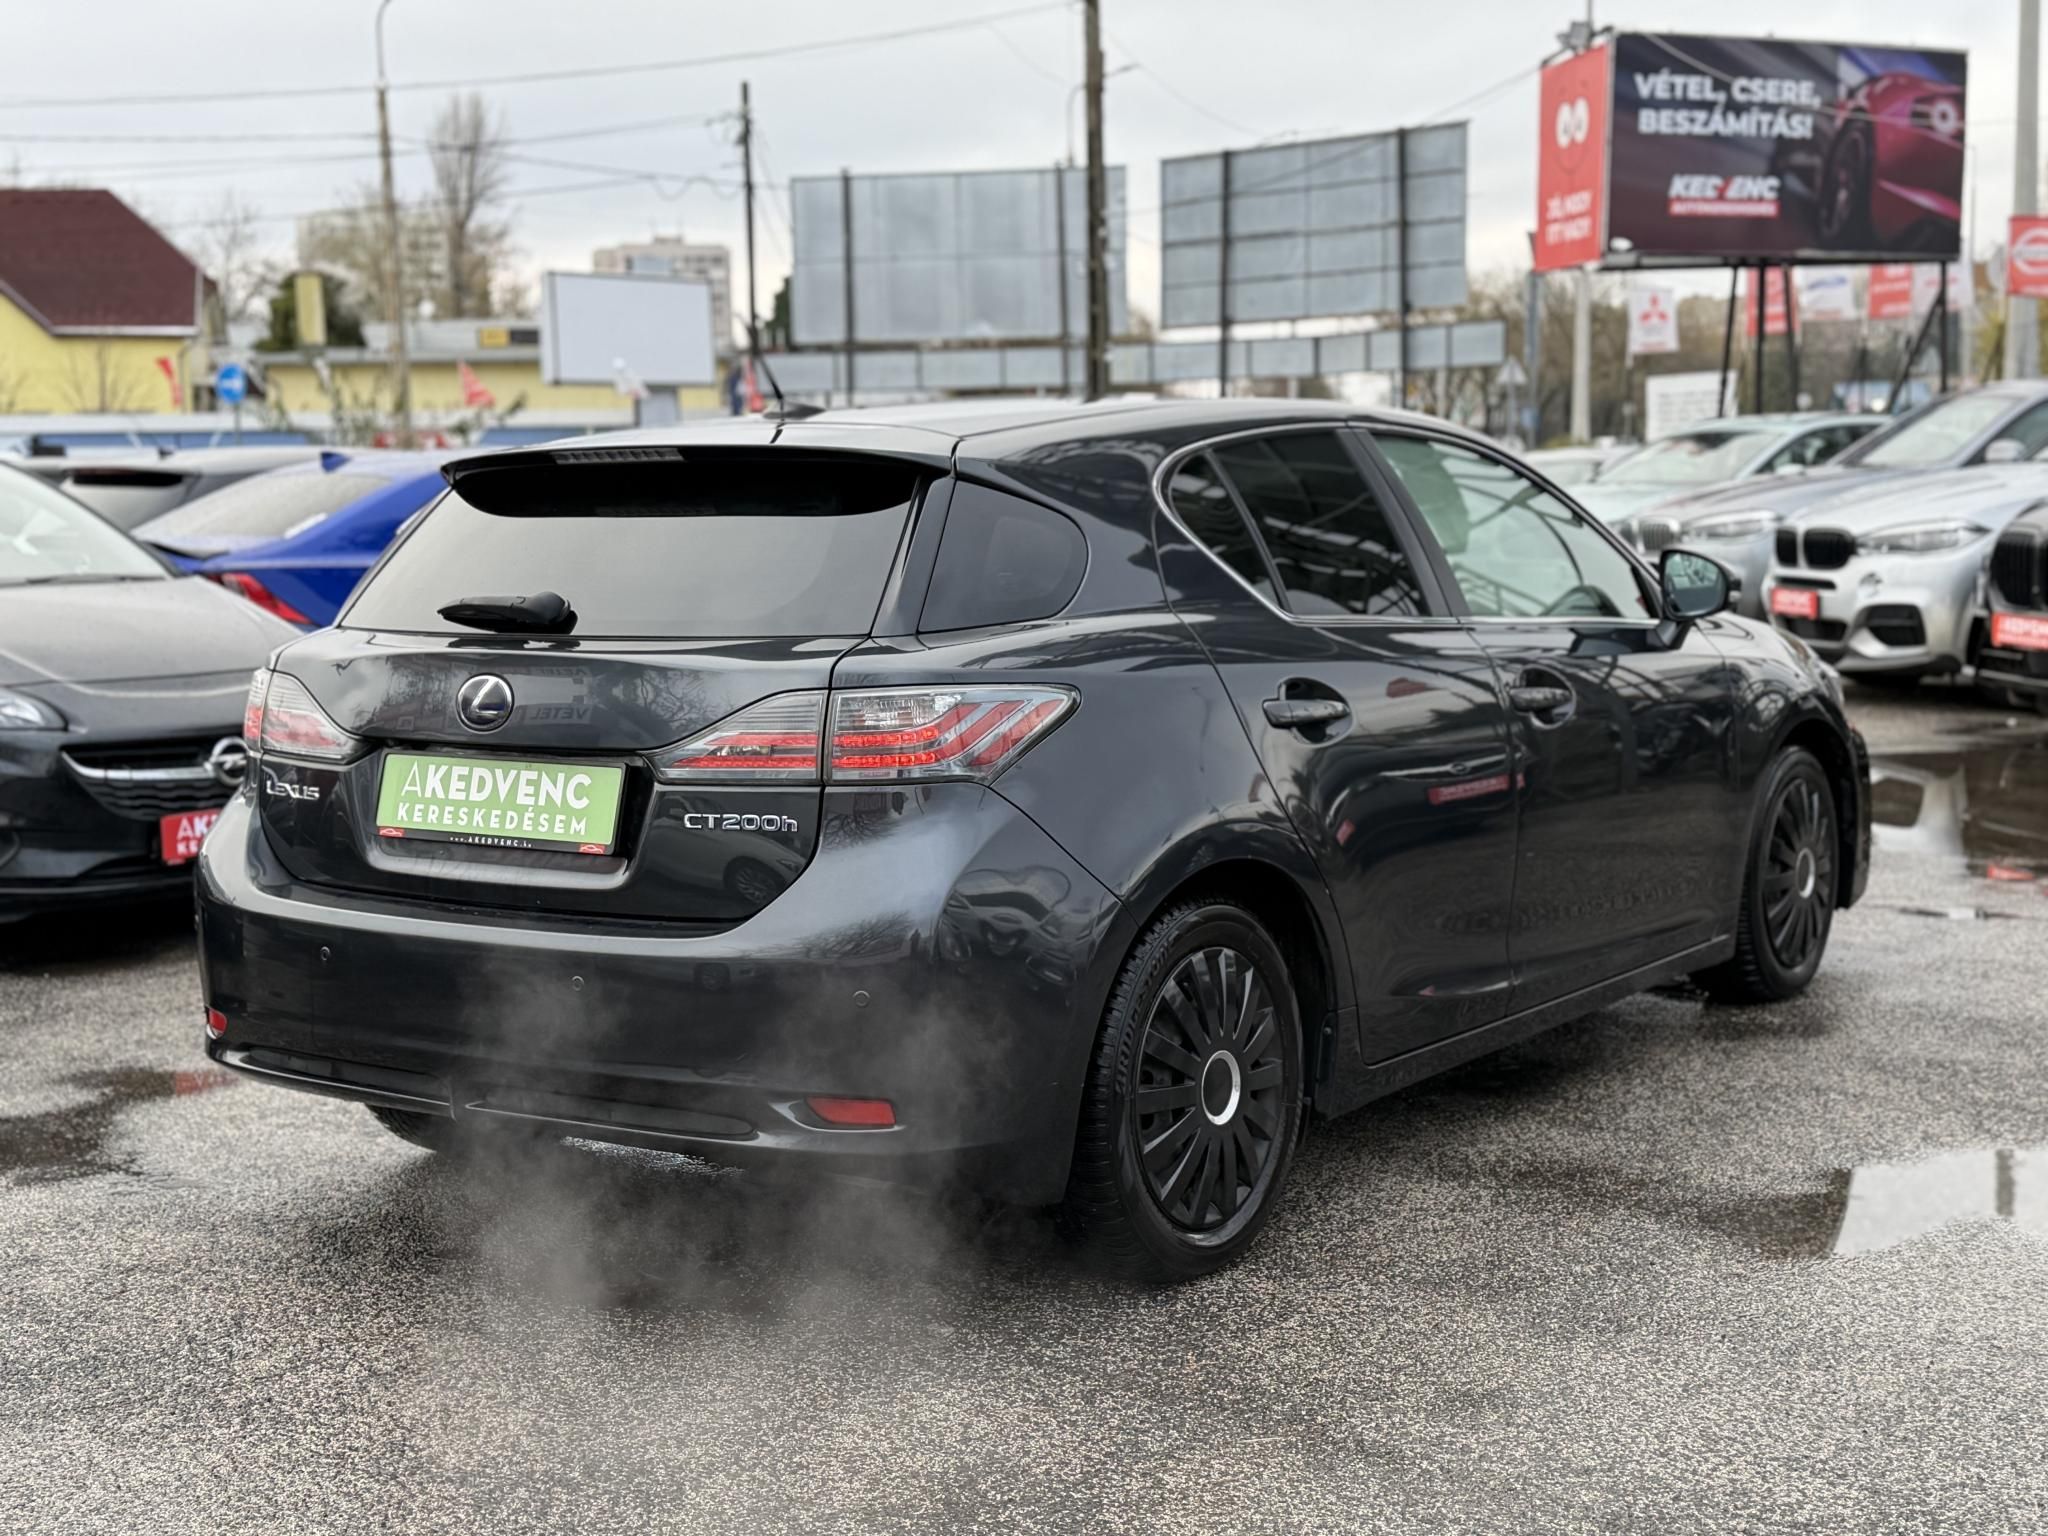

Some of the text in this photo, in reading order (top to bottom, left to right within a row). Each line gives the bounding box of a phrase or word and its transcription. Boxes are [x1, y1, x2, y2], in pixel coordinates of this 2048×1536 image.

[1634, 67, 1822, 108] VÉTEL, CSERE,
[1638, 103, 1814, 139] BESZÁMÍTÁS!
[266, 780, 320, 800] LEXUS
[401, 760, 592, 810] AKEDVENC
[397, 803, 587, 836] KERESKEDÉSEM
[684, 813, 798, 832] CT200h
